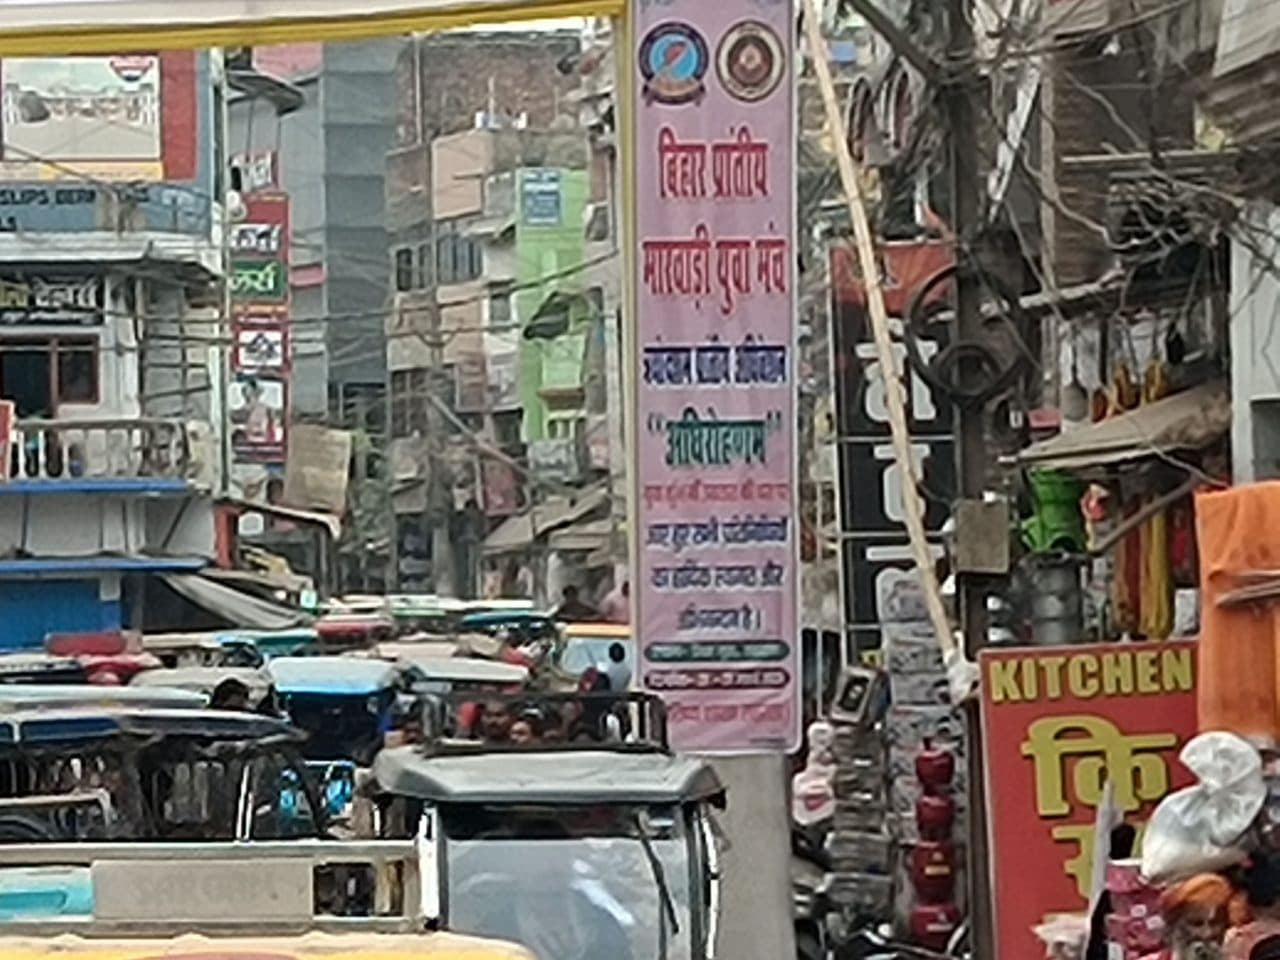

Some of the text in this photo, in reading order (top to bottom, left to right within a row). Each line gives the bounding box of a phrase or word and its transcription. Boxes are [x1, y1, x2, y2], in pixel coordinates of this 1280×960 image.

[659, 126, 768, 198] बिहार प्रांतीय
[715, 240, 751, 315] युवा
[755, 221, 786, 294] मंच
[988, 648, 1194, 702] KITCHEN
